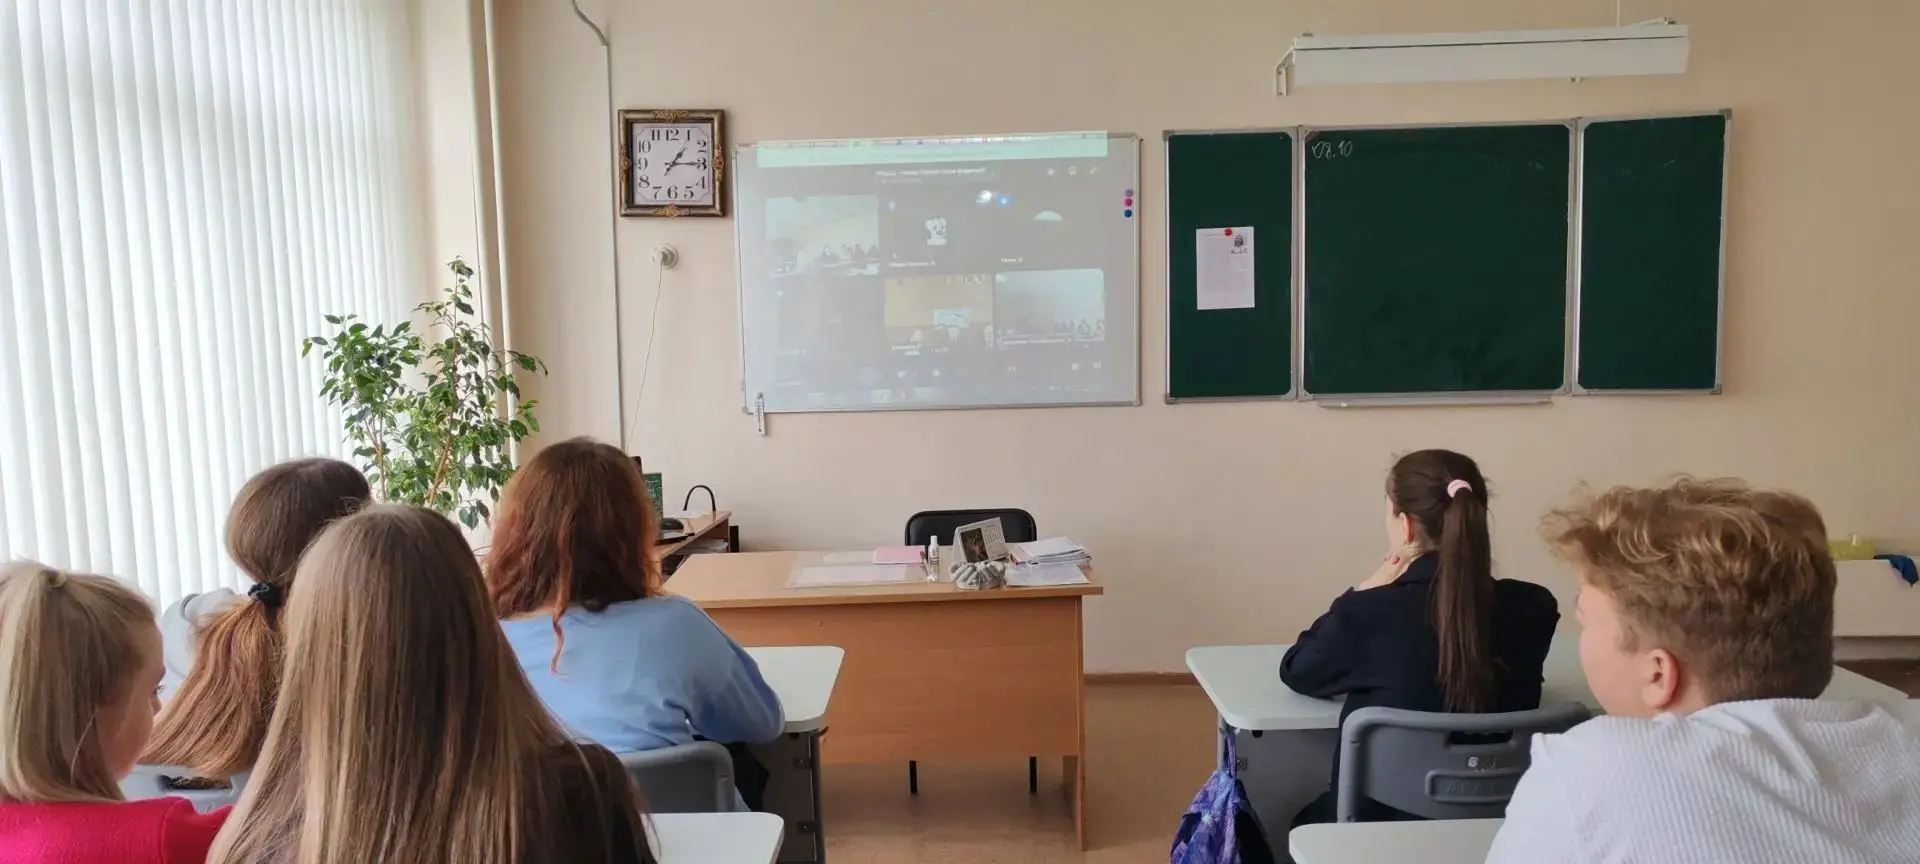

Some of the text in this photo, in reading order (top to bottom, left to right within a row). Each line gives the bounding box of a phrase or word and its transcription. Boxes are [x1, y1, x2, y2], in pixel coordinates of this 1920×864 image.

[651, 129, 660, 141] 11
[665, 129, 680, 141] 12
[638, 140, 651, 153] 10
[697, 140, 707, 153] 2
[638, 157, 648, 170] 9
[697, 157, 707, 170] 3
[638, 175, 650, 188] 8
[653, 186, 662, 199] 7
[667, 185, 678, 199] 6
[684, 186, 694, 199] 5
